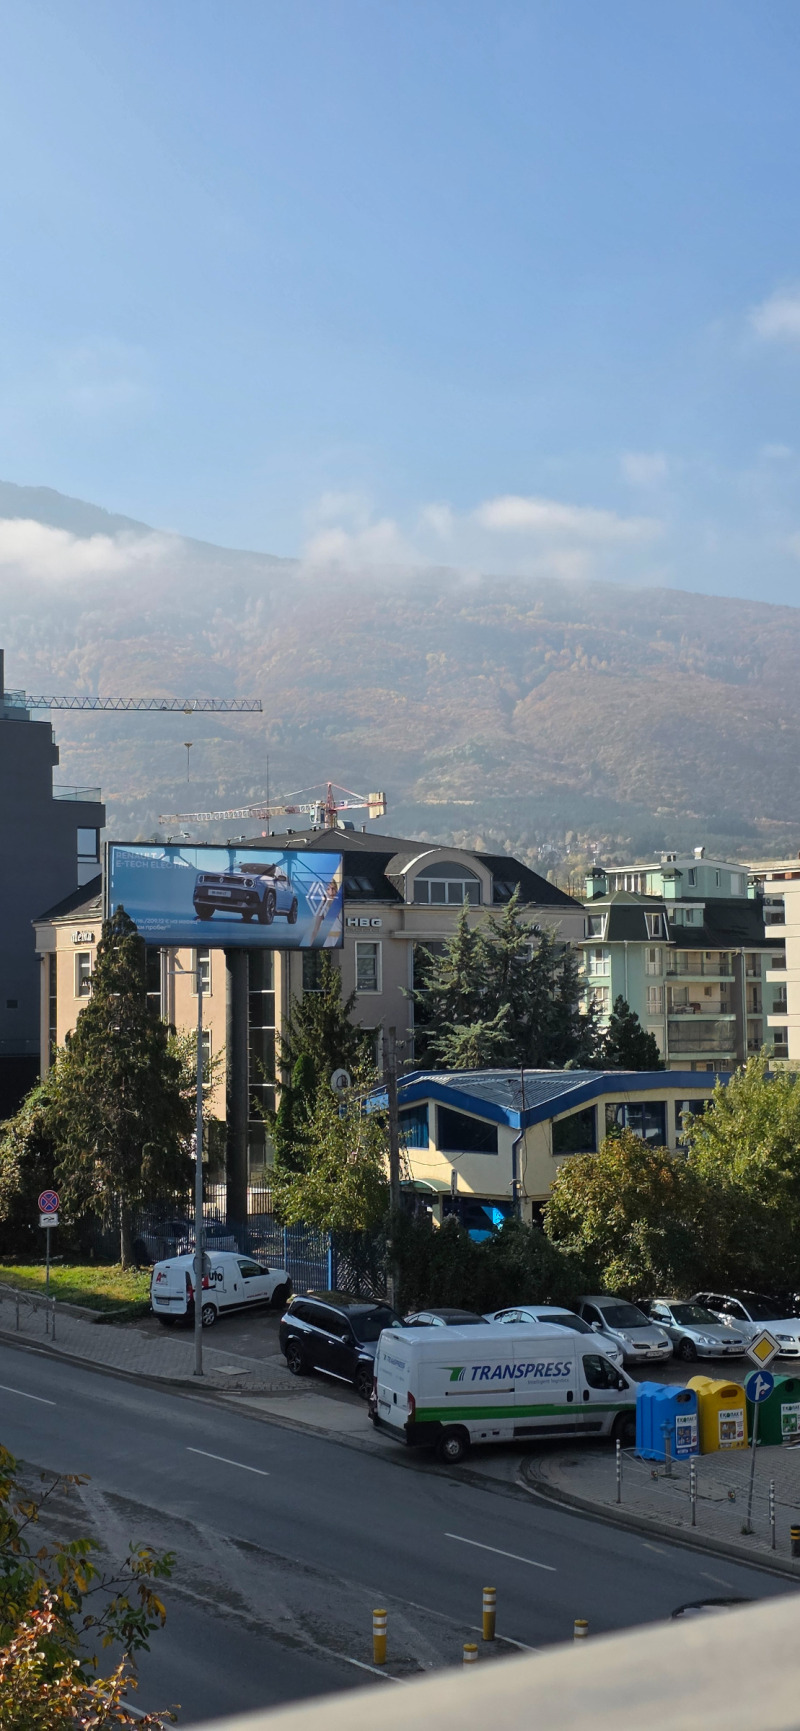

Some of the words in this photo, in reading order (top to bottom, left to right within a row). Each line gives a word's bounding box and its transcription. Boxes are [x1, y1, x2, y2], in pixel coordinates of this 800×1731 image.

[116, 852, 157, 860] RENAULT
[116, 860, 149, 868] E-TECH
[346, 917, 382, 927] HBG
[471, 1362, 572, 1381] TRANSPRESS
